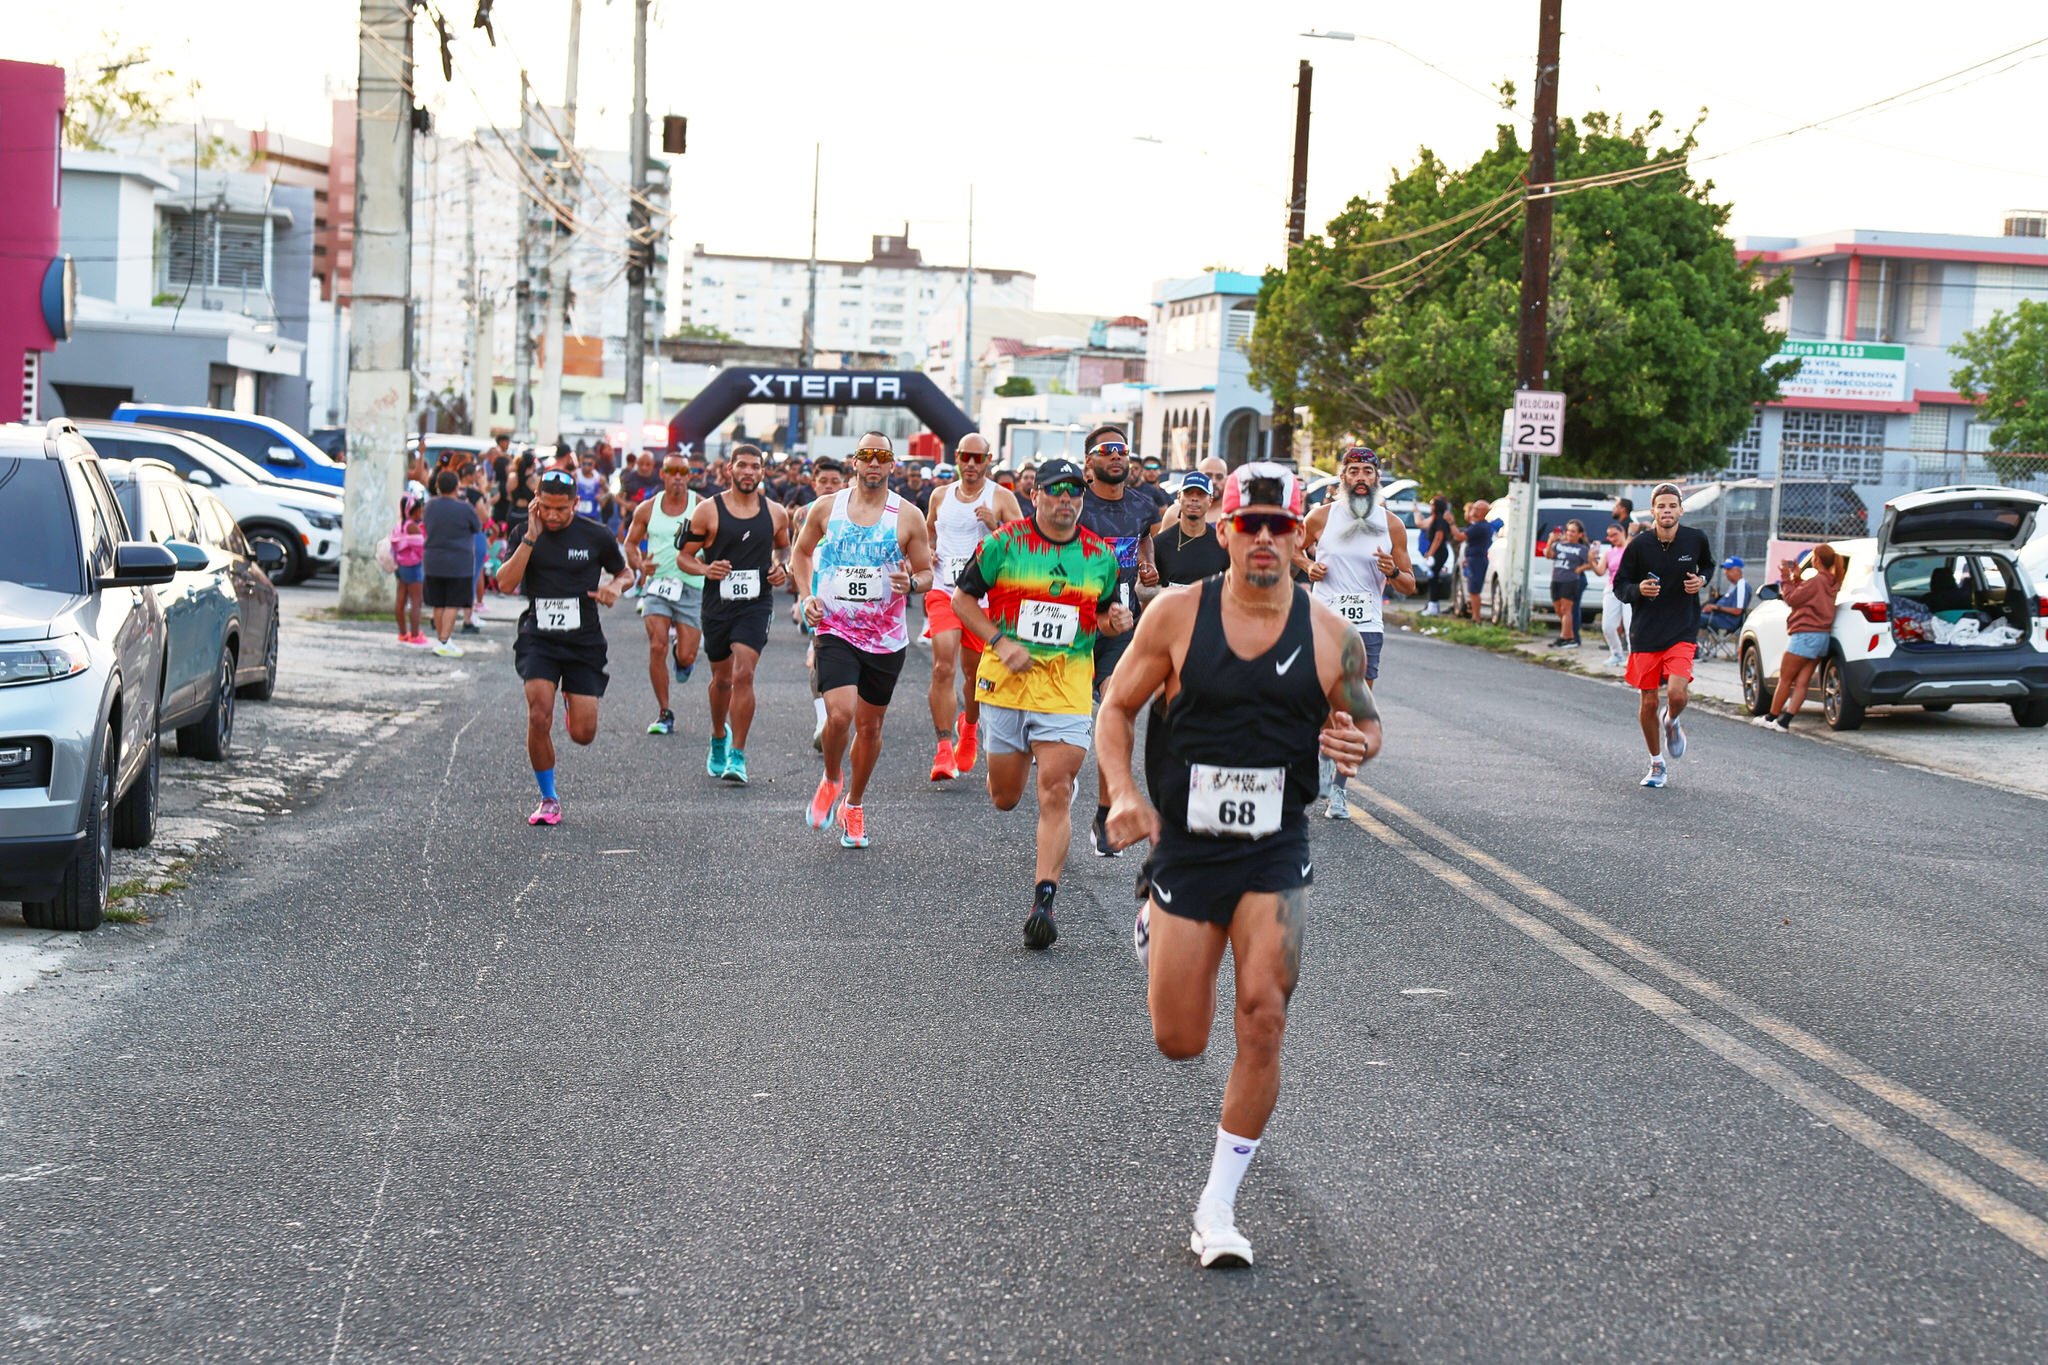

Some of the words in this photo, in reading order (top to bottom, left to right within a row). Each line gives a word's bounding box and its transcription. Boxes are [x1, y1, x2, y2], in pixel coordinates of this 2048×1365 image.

[1816, 345, 1838, 356] IPA
[1838, 370, 1897, 380] PREVENTIVA
[1520, 399, 1560, 410] VELOCIDAD
[1521, 411, 1556, 422] MAXIMA
[1518, 424, 1556, 447] 25
[834, 541, 887, 558] RUNNING
[733, 584, 749, 595] 86
[848, 582, 868, 596] 85
[548, 613, 566, 626] 72
[1340, 607, 1364, 620] 193
[1031, 621, 1063, 640] 181
[1218, 800, 1256, 826] 68
